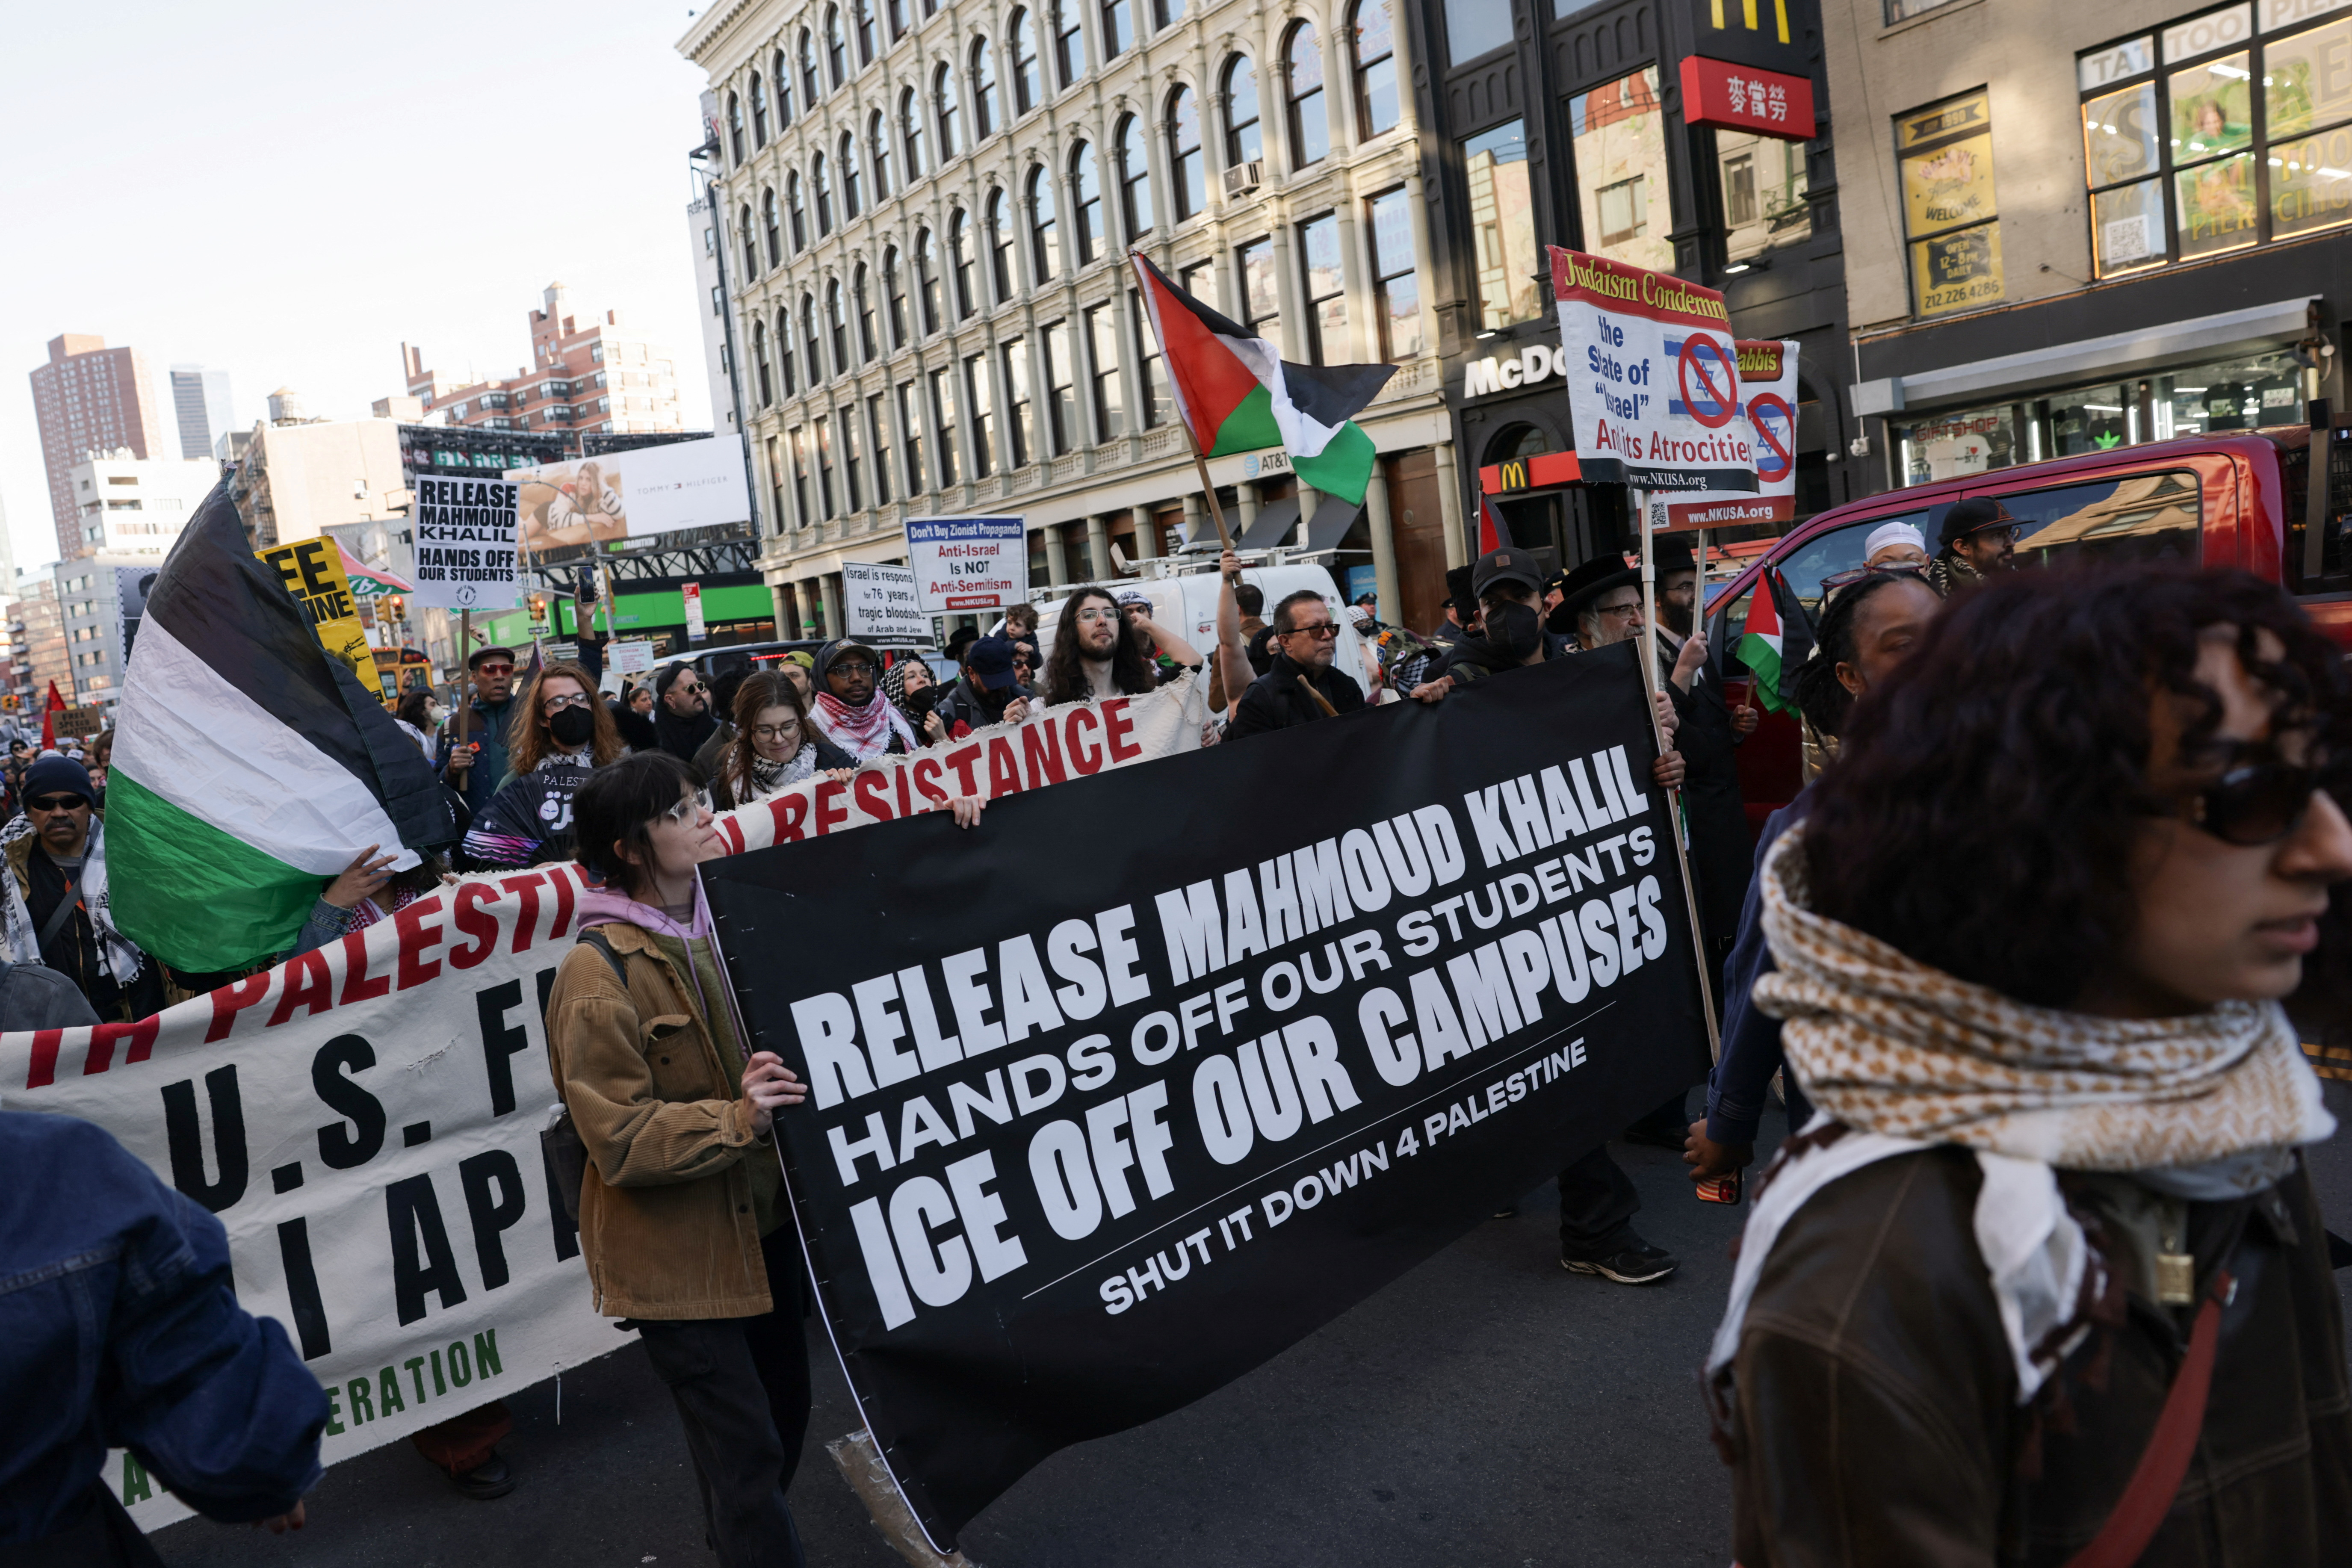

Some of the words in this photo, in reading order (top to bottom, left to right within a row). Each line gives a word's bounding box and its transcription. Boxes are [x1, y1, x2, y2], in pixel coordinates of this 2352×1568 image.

[1941, 109, 1966, 128] 1990
[1926, 193, 1981, 221] WELCOME
[1946, 239, 1970, 254] OPEN
[1563, 254, 1639, 301] Judaism
[1947, 264, 1972, 279] DAILY
[1598, 315, 1623, 347] the
[1588, 345, 1622, 383] State
[1628, 358, 1649, 386] of
[1622, 426, 1643, 459] its
[1262, 452, 1289, 471] AT&T
[638, 485, 669, 495] TOMMY
[687, 476, 728, 487] HILFIGER
[1629, 472, 1707, 490] www.NKUSA.org
[420, 480, 517, 508] RELEASE
[420, 505, 515, 528] MAHMOUD
[1688, 506, 1773, 523] www.NKUSA.org
[420, 526, 515, 543] KHALIL
[934, 525, 948, 539] Buy
[950, 524, 977, 536] Zionist
[979, 523, 1020, 537] Propaganda
[419, 548, 480, 567] HANDS
[486, 549, 514, 567] OFF
[938, 543, 999, 557] Anti-Israel
[265, 541, 337, 599] EE
[419, 567, 445, 580] OUR
[450, 568, 514, 582] STUDENTS
[846, 567, 869, 580] Israel
[872, 569, 879, 580] is
[882, 572, 913, 584] respons
[950, 563, 960, 575] Is
[965, 561, 989, 574] NOT
[872, 588, 883, 599] 76
[887, 591, 908, 602] years
[930, 578, 1012, 594] Anti-Semitism
[301, 590, 354, 624] INE
[951, 598, 994, 606] www.NKUSA.org
[859, 606, 882, 621] tragic
[886, 606, 925, 619] bloodshe
[543, 775, 588, 786] PALEST
[204, 864, 592, 1043] PALESTI
[767, 698, 1143, 847] RESISTANCE
[790, 904, 1151, 1110] RELEASE
[1155, 805, 1465, 986] MAHMOUD
[1464, 745, 1649, 868] KHALIL
[827, 1034, 1116, 1186] HANDS
[1132, 978, 1249, 1065] OFF
[1262, 930, 1392, 1011] OUR
[1397, 826, 1655, 957] STUDENTS
[160, 1034, 431, 1214] U.S.
[476, 967, 557, 1117] F
[850, 1149, 1028, 1331] ICE
[1028, 1080, 1174, 1240] OFF
[1193, 1016, 1362, 1164] OUR
[1359, 875, 1666, 1086] CAMPUSES
[1100, 1227, 1211, 1314] SHUT
[1219, 1205, 1252, 1251] IT
[1261, 1141, 1389, 1228] DOWN
[1396, 1127, 1419, 1157] 4
[1424, 1037, 1584, 1146] PALESTINE
[324, 1329, 502, 1436] ERATION
